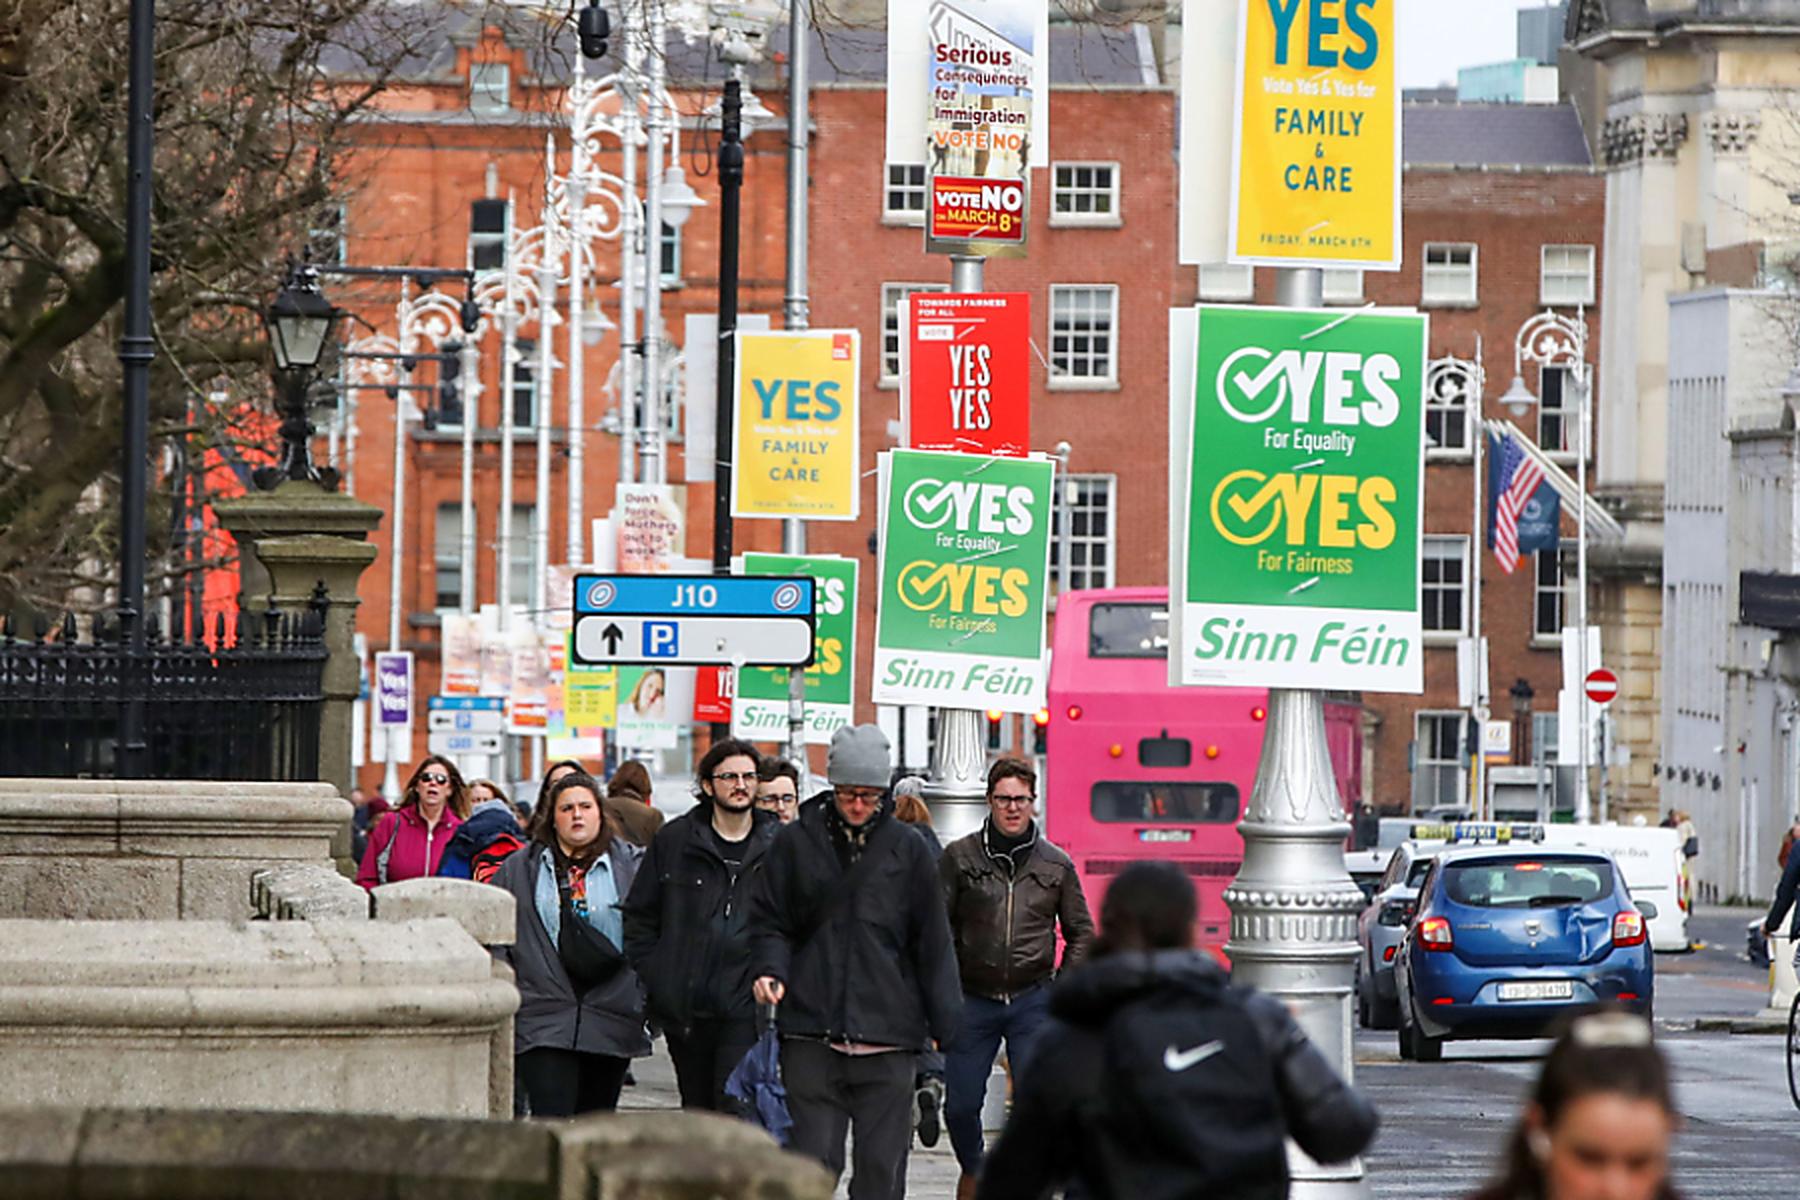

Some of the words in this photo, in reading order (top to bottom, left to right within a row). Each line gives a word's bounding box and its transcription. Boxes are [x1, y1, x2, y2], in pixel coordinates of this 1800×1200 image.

[1267, 0, 1379, 71] YES
[936, 44, 1012, 65] Serious
[935, 69, 1028, 86] Consequences
[1264, 78, 1292, 94] Vote
[1296, 79, 1318, 95] Yes
[1334, 81, 1354, 96] Yes
[936, 86, 956, 100] for
[935, 106, 1025, 124] Immigration
[1275, 108, 1364, 136] FAMILY
[936, 131, 986, 149] VOTE
[993, 134, 1021, 150] NO
[1315, 142, 1324, 158] &
[1285, 164, 1352, 192] CARE
[936, 192, 980, 208] VOTE
[982, 186, 1022, 211] NO
[948, 210, 996, 223] MARCH
[949, 345, 991, 387] YES
[752, 378, 842, 422] YES
[1281, 350, 1401, 427] YES
[949, 388, 991, 430] YES
[762, 440, 829, 454] FAMILY
[1264, 428, 1289, 448] For
[1293, 429, 1355, 456] Equality
[769, 467, 819, 482] CARE
[951, 481, 1034, 535] YES
[1278, 473, 1396, 549] YES
[936, 532, 954, 547] For
[957, 534, 1000, 551] Equality
[1258, 551, 1283, 571] For
[1287, 552, 1352, 575] Fairness
[815, 577, 845, 615] ES
[946, 563, 1029, 617] YES
[929, 615, 946, 629] For
[1195, 617, 1298, 661] Sinn
[1310, 622, 1410, 667] Féin
[804, 637, 842, 675] ES
[882, 659, 954, 690] Sinn
[963, 664, 1033, 695] Féin
[1460, 825, 1491, 840] TAXI
